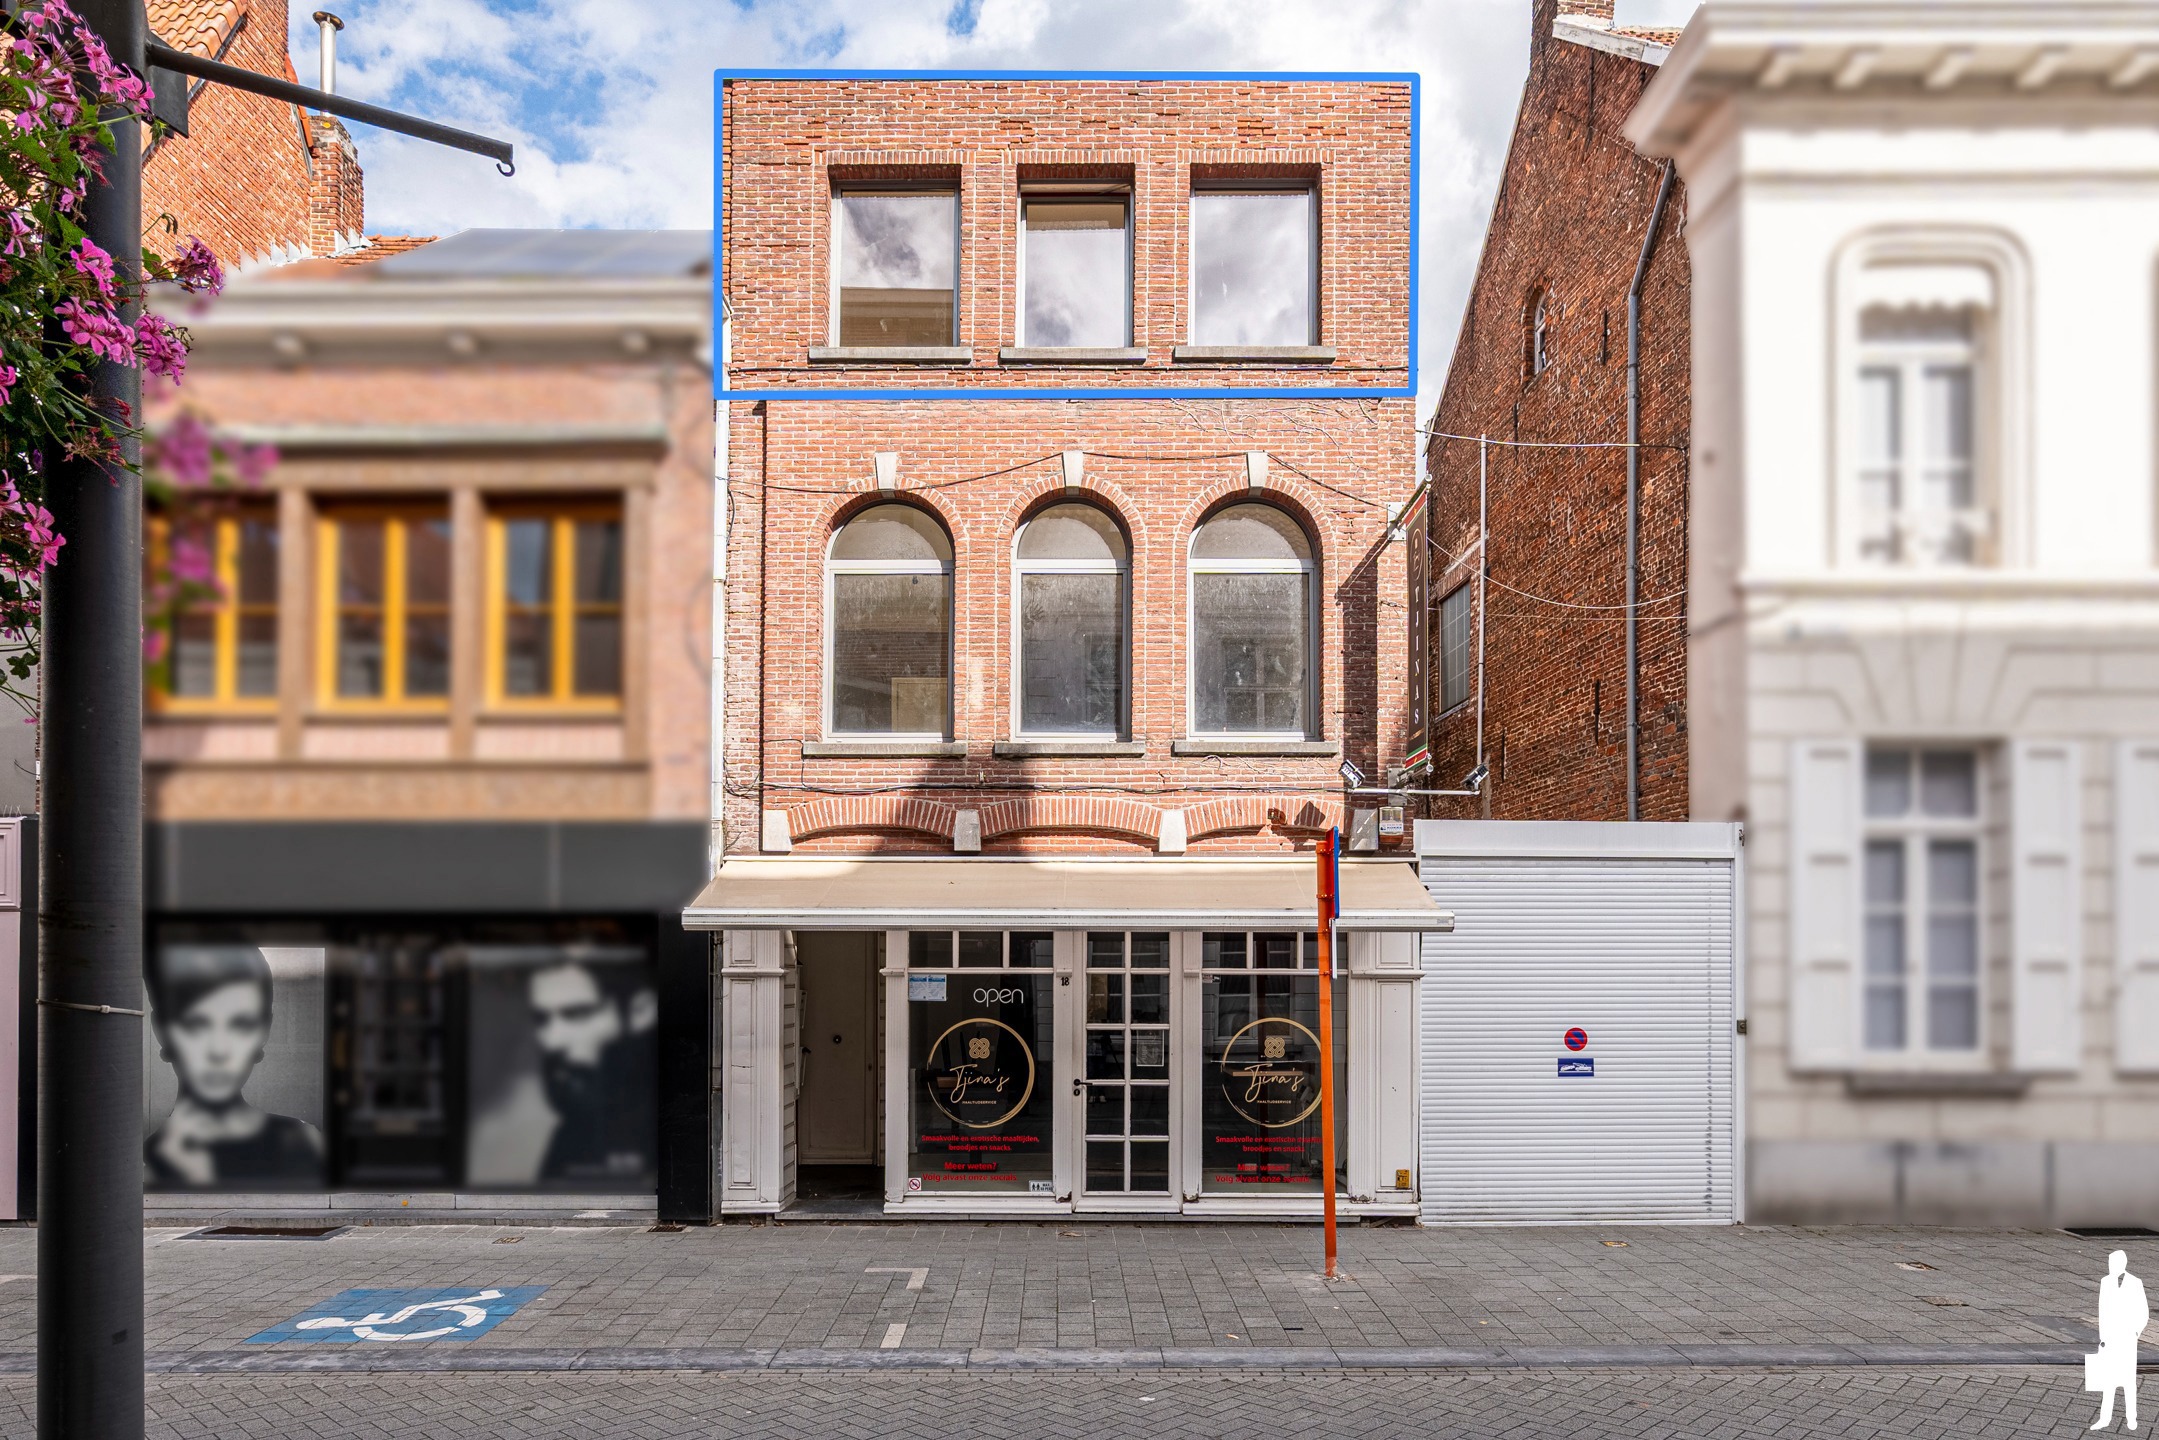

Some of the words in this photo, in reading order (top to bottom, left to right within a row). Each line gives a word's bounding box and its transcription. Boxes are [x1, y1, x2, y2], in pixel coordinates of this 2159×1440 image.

[1061, 977, 1070, 986] 18
[973, 988, 1024, 1007] open
[949, 1063, 1010, 1103] Tjina's
[1244, 1063, 1305, 1103] Tjina's
[948, 1144, 978, 1152] broodjes
[944, 1162, 965, 1170] Meer
[967, 1162, 997, 1170] weten?
[922, 1173, 940, 1182] Volg
[943, 1173, 966, 1181] alvast
[1215, 1175, 1234, 1184] Volg
[1235, 1175, 1259, 1183] alvast
